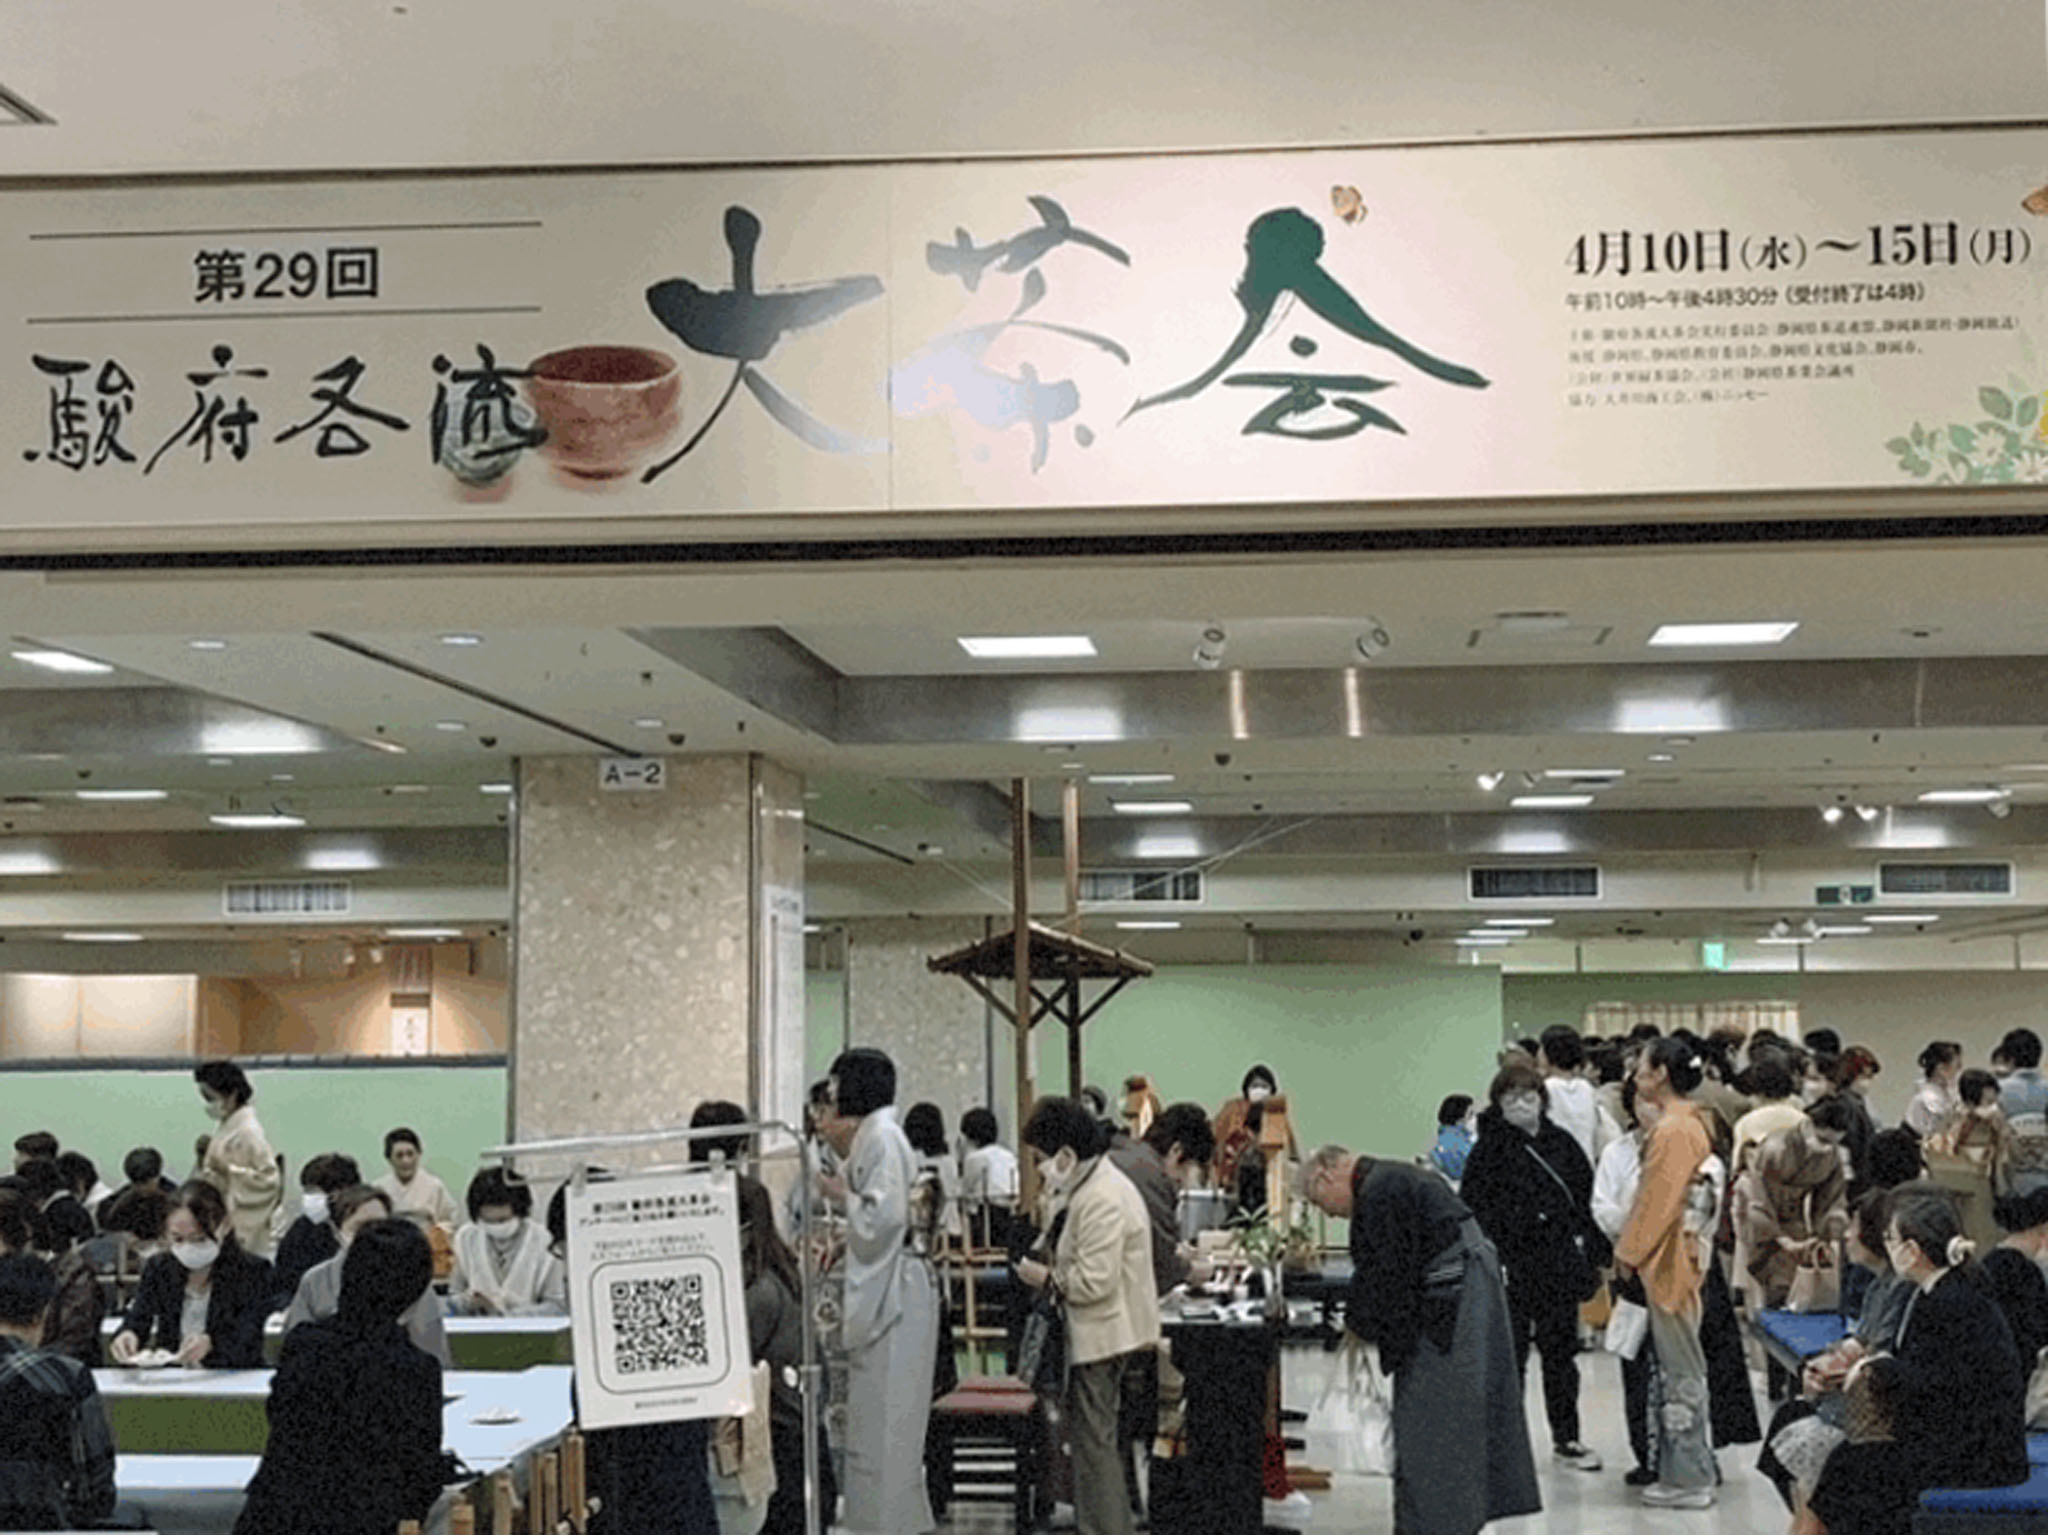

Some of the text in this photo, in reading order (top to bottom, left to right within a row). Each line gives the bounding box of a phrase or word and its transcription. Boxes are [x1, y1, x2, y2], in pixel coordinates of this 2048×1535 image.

[194, 246, 380, 302] 第29回
[641, 194, 1490, 483] 大茶会
[23, 343, 549, 474] 駿府各流
[604, 762, 662, 785] A-2
